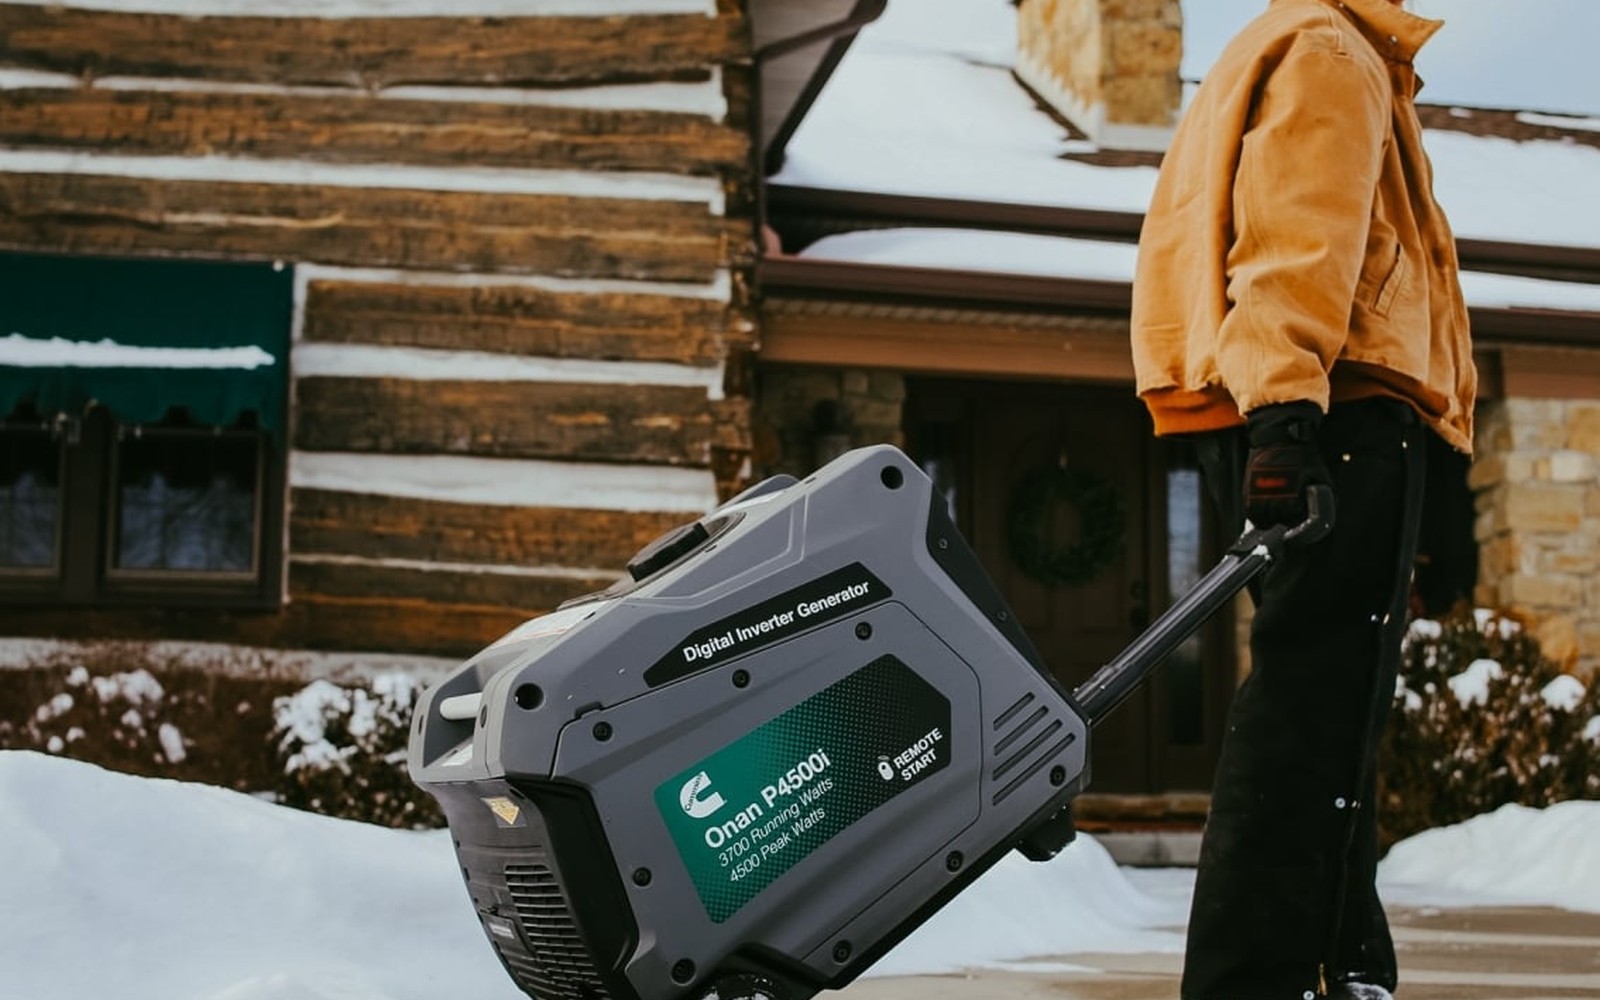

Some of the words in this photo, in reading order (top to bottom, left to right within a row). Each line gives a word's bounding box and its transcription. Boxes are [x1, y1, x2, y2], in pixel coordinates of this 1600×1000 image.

[683, 632, 735, 662] Digital
[736, 611, 794, 642] Inverter
[796, 581, 870, 618] Generator
[893, 727, 943, 769] REMOTE
[901, 748, 937, 781] START
[704, 802, 763, 848] Onan
[760, 748, 831, 808] P4500i
[718, 836, 750, 867] 3700
[750, 803, 800, 844] Running
[798, 777, 833, 806] Watts
[730, 853, 760, 882] 4500
[760, 831, 792, 860] Peak
[791, 807, 825, 836] Watts
